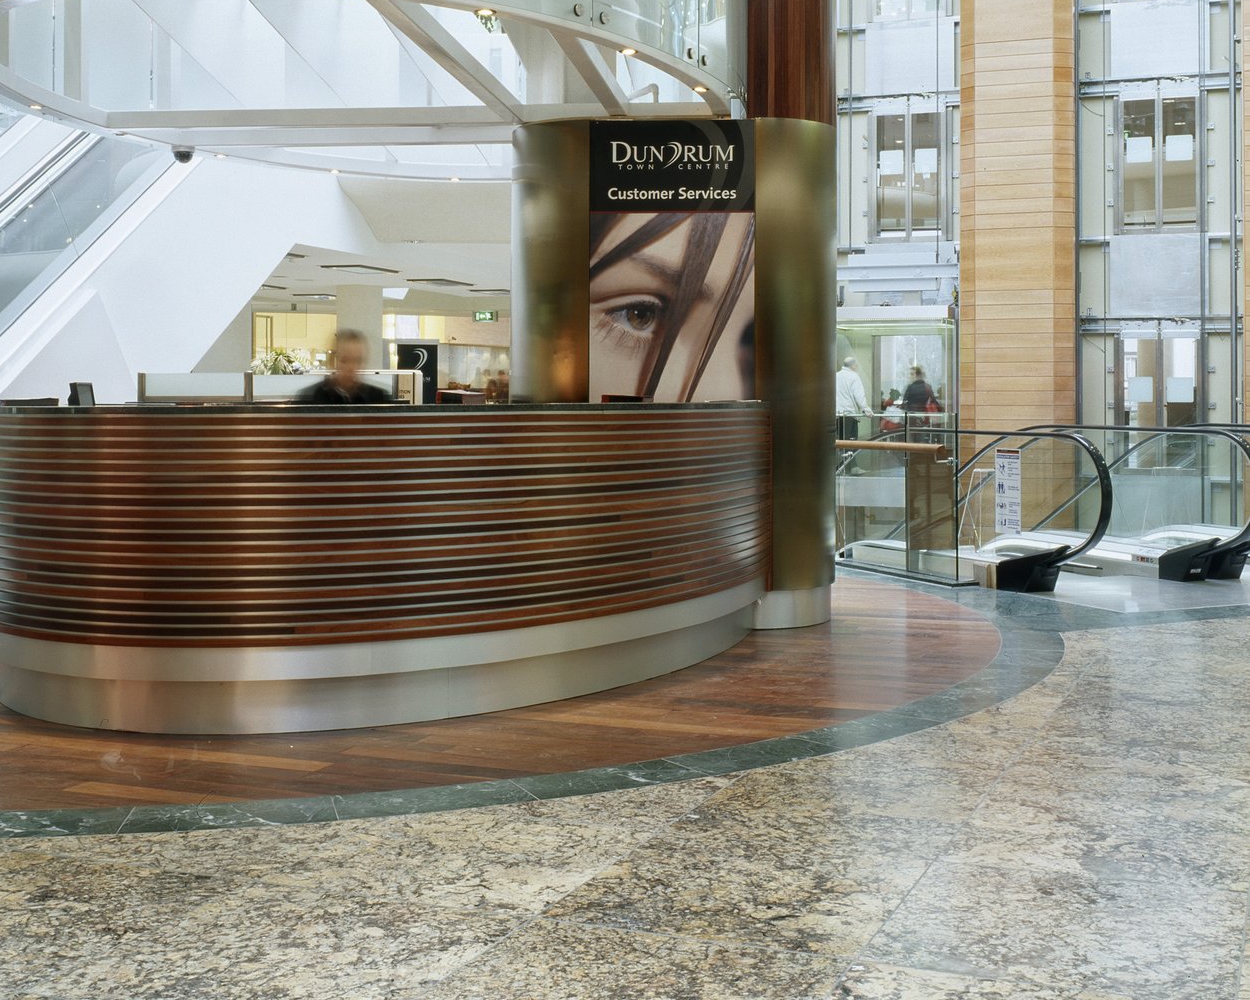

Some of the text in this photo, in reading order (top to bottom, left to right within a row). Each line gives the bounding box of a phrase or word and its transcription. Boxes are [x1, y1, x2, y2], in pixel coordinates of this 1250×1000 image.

[610, 141, 735, 167] DUNDRUM
[608, 187, 737, 200] Customer Services
